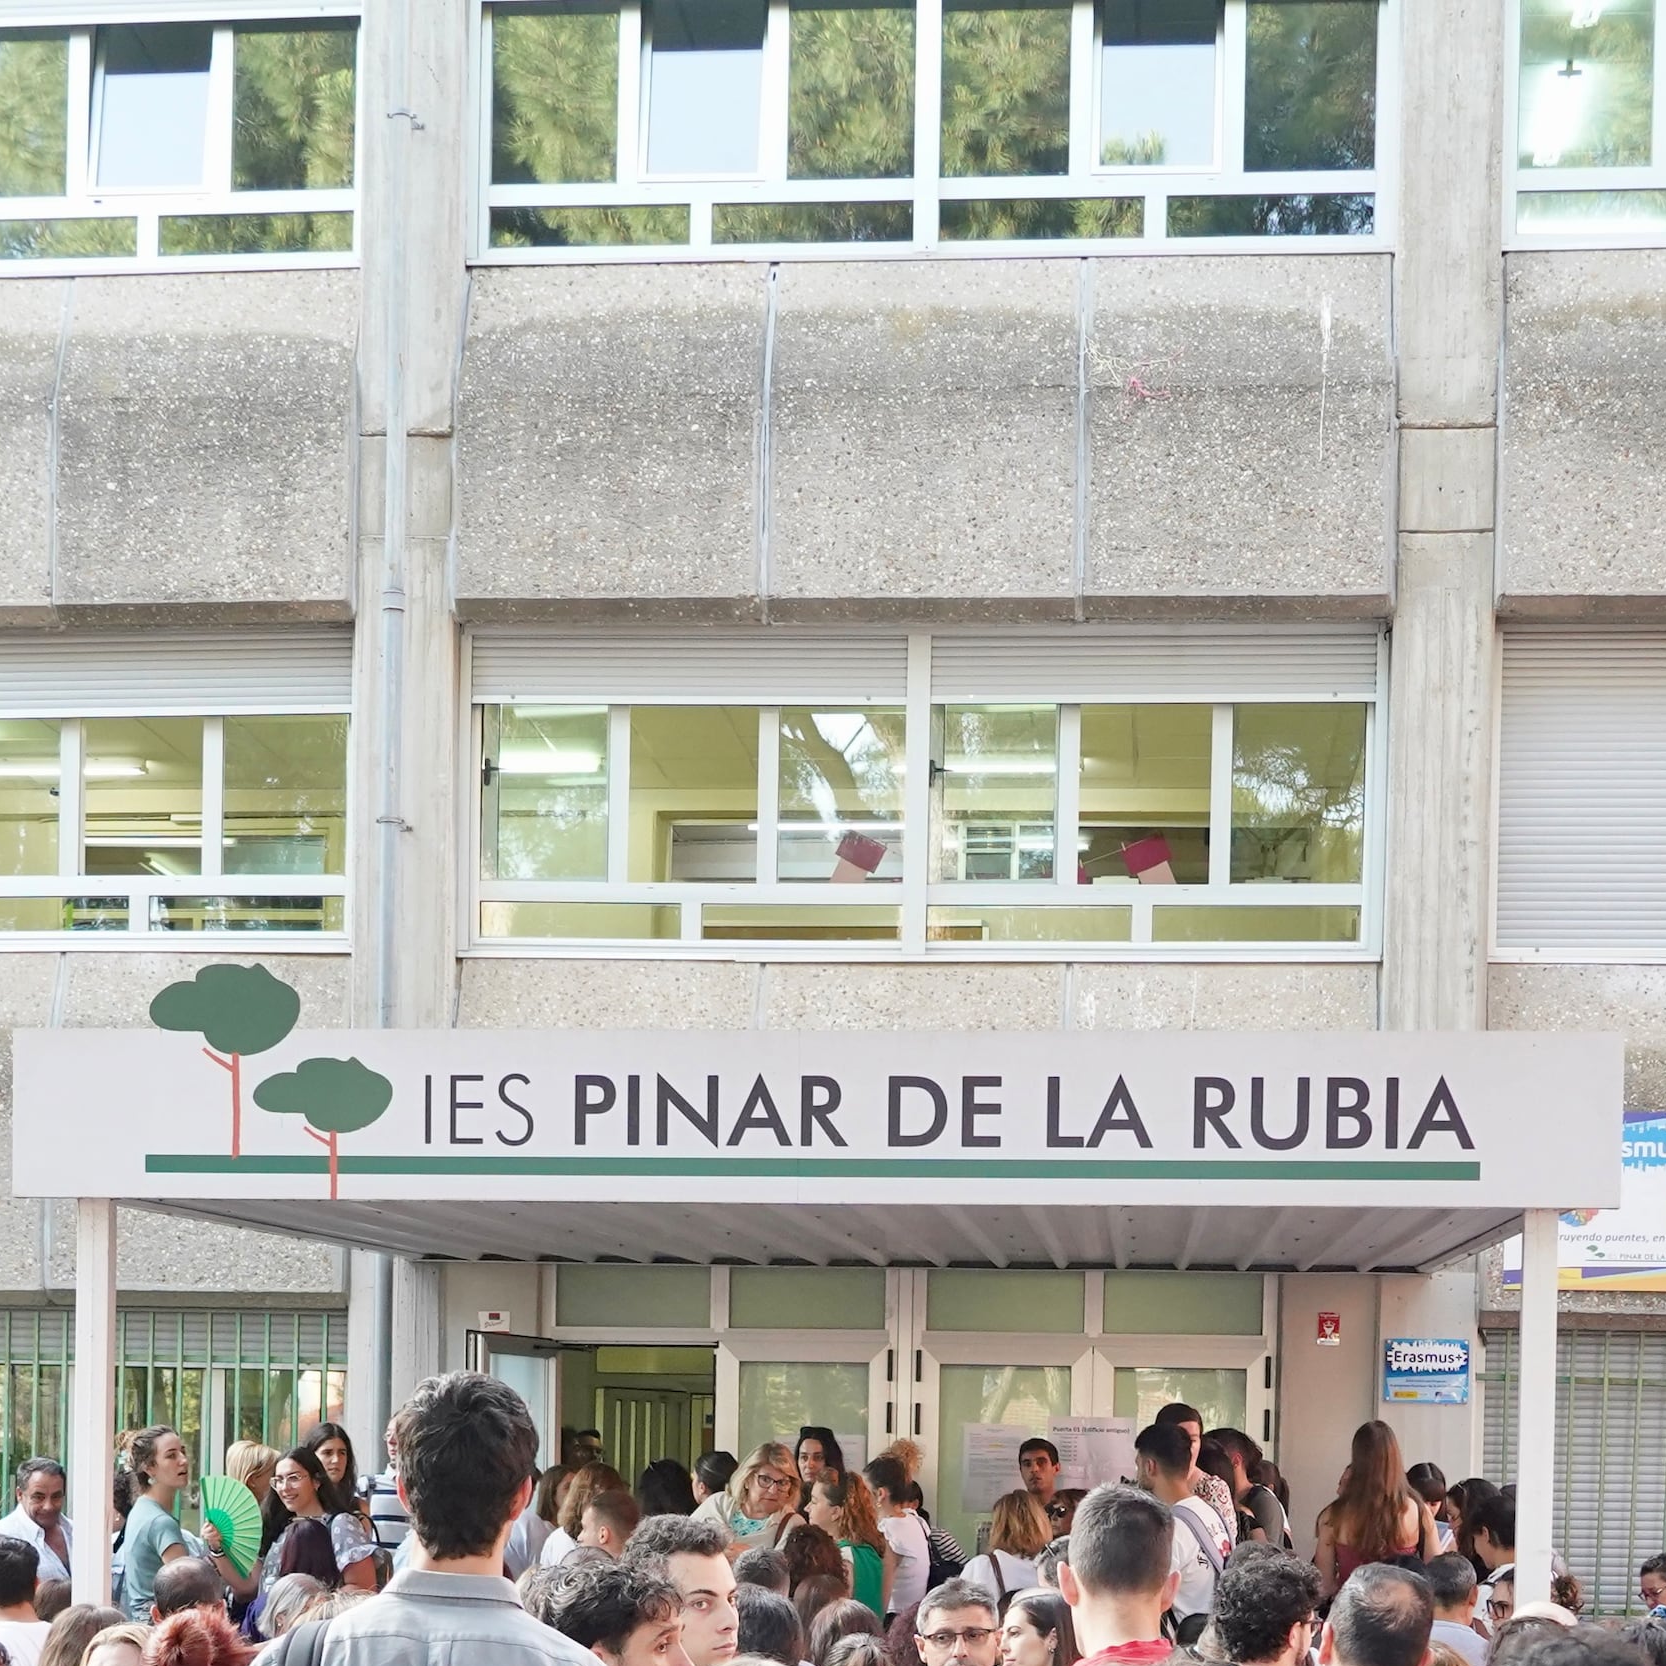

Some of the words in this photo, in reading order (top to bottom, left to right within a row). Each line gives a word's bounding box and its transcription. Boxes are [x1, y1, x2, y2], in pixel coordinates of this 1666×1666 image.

[424, 1072, 534, 1147] IES
[574, 1072, 849, 1149] PINAR
[887, 1074, 1002, 1148] DE
[1046, 1073, 1154, 1149] LA
[1193, 1074, 1476, 1151] RUBIA
[1559, 1233, 1602, 1243] ruyendo
[1604, 1234, 1649, 1244] puentes,
[1394, 1350, 1463, 1364] Erasmus+
